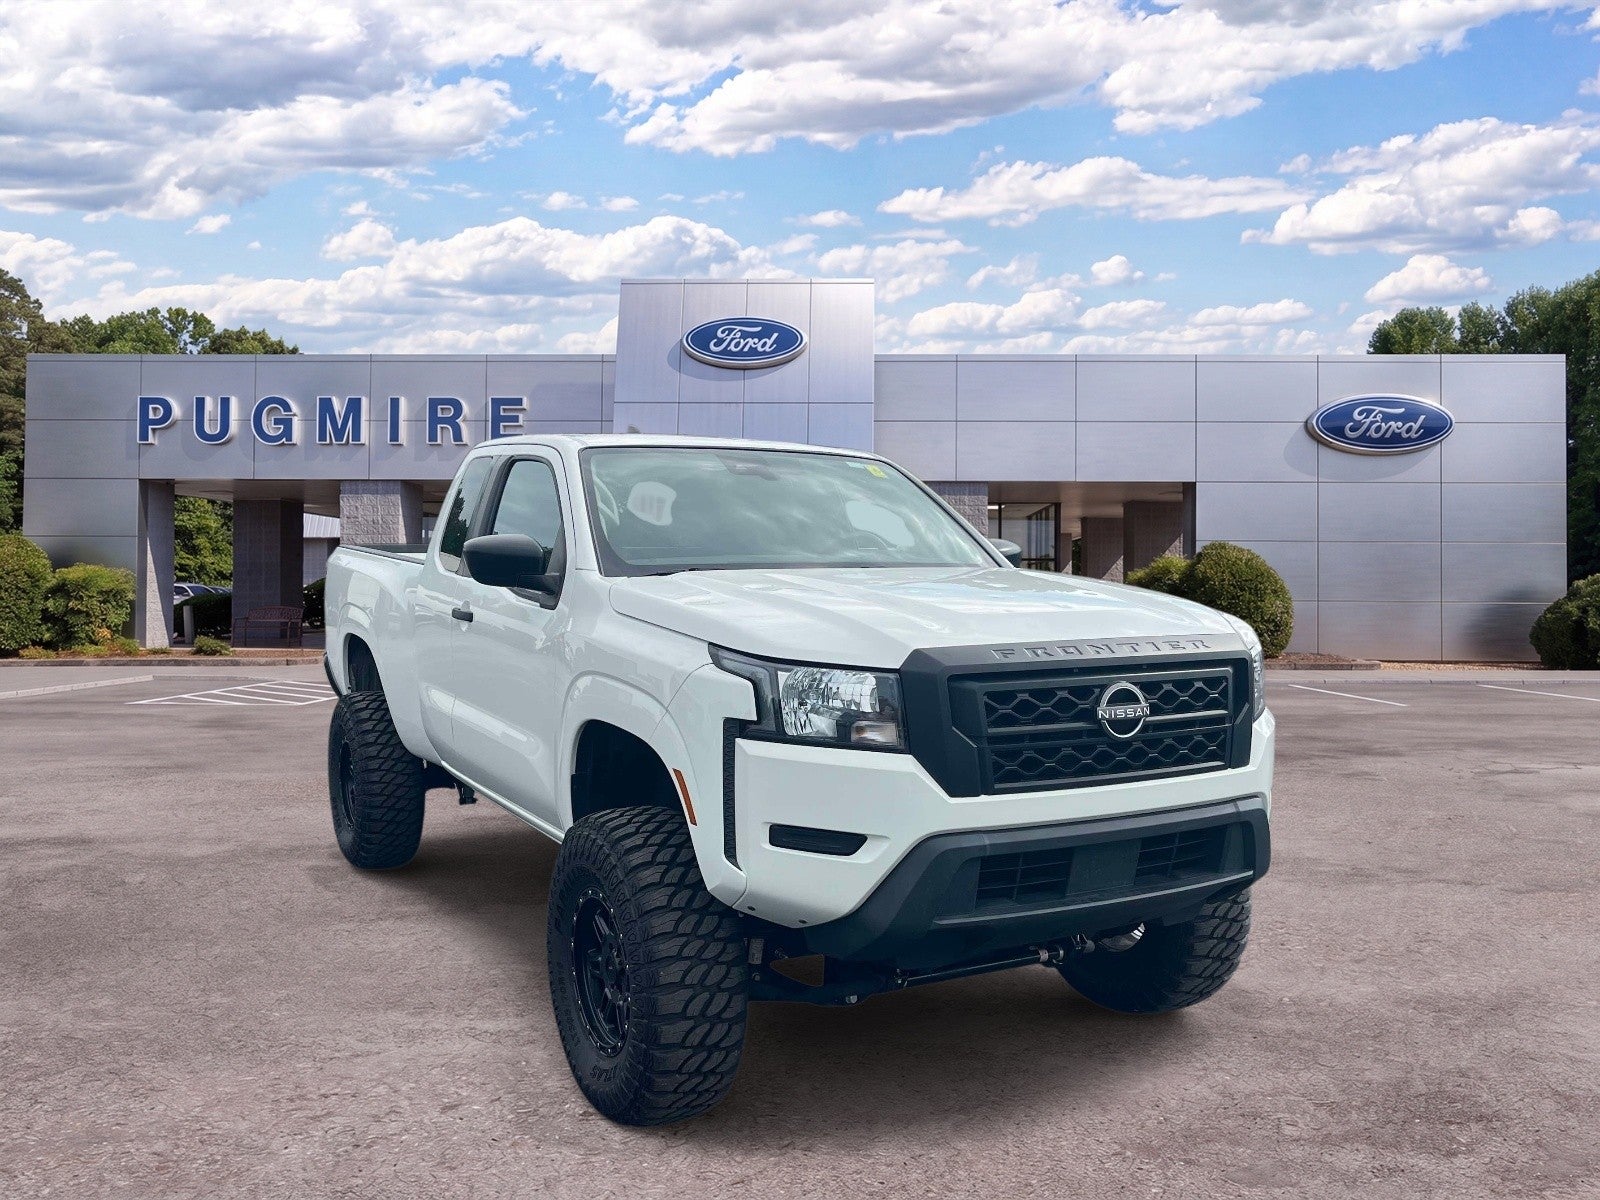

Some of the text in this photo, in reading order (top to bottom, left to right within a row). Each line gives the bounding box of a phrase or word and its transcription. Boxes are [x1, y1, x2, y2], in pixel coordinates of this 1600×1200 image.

[709, 325, 779, 352] Ford
[137, 396, 527, 445] PUGMIRE
[1344, 405, 1426, 439] Ford
[991, 639, 1213, 660] FRONTIER
[1098, 706, 1151, 719] NISSAN
